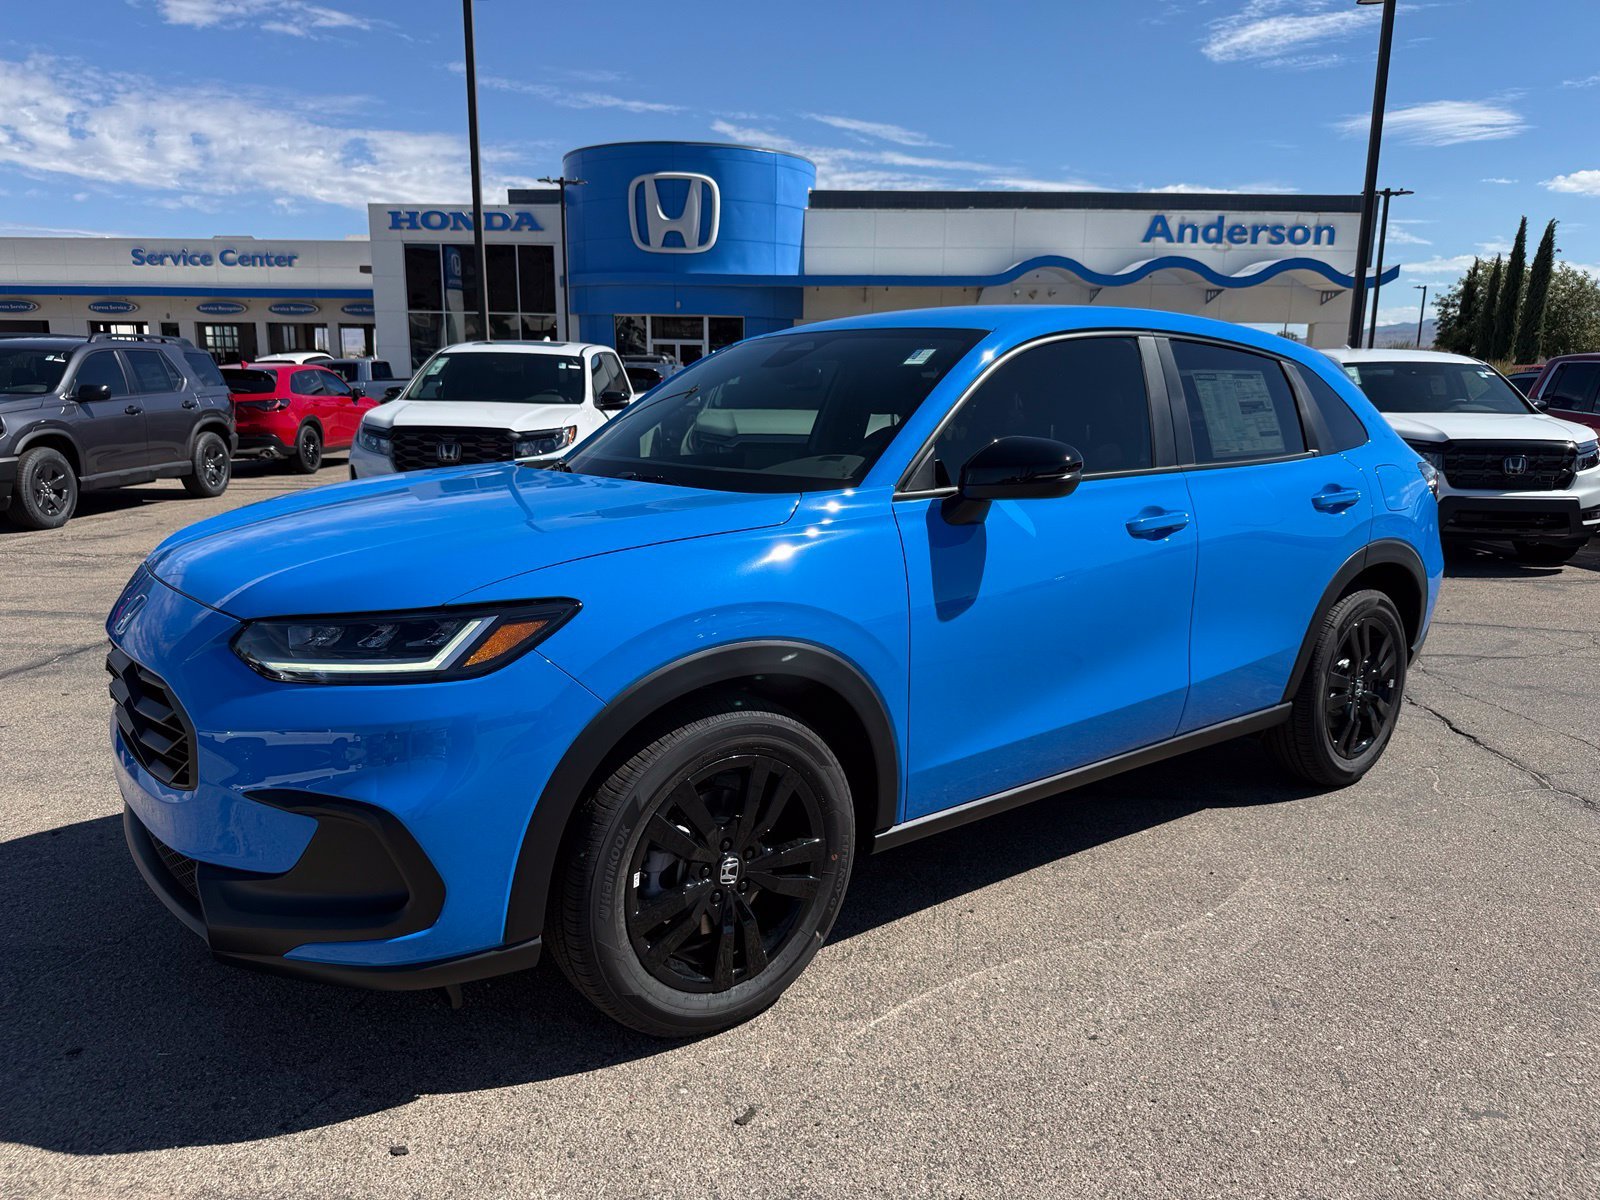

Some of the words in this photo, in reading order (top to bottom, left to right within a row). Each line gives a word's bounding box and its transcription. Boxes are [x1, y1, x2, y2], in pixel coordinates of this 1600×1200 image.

[387, 210, 544, 231] HONDA
[1141, 214, 1336, 246] Anderson
[131, 248, 213, 267] Service
[218, 248, 298, 268] Center
